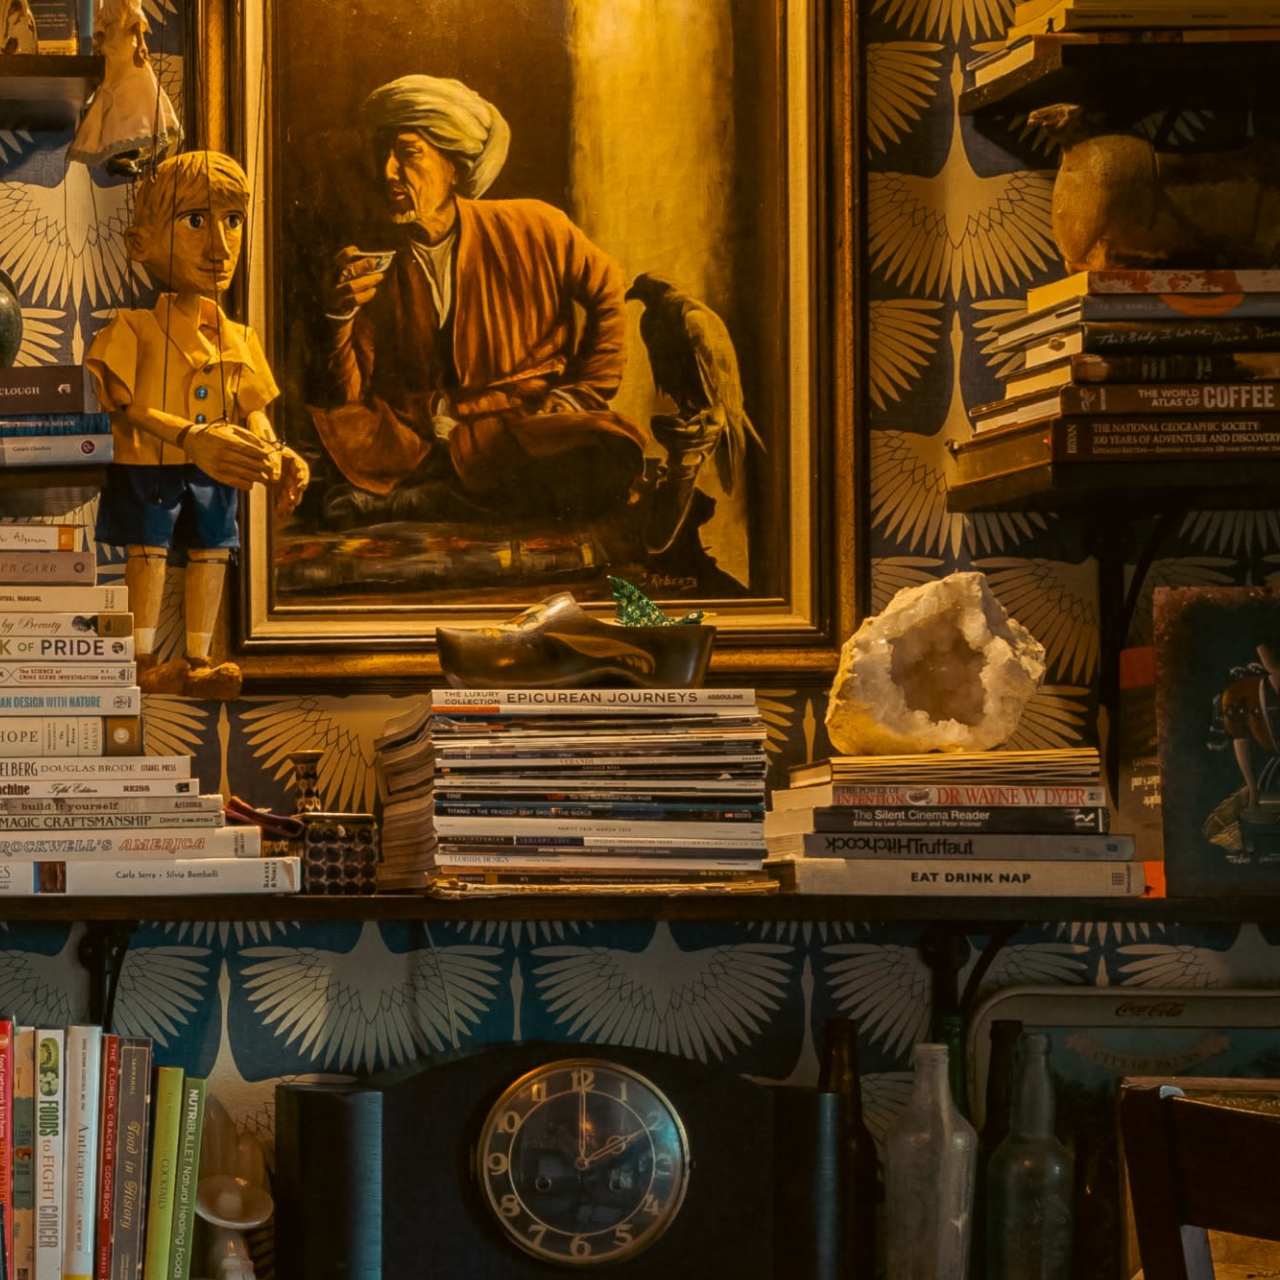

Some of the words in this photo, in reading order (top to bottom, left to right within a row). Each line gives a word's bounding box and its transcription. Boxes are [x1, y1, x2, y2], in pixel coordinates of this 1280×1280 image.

[1151, 398, 1183, 408] ATLAS
[1161, 388, 1200, 398] WORLD
[1202, 385, 1275, 409] COFFEE
[1112, 422, 1160, 433] NATIONAL
[1152, 433, 1208, 444] ADVENTURE
[17, 642, 35, 652] OF
[40, 639, 105, 657] PRIDE
[444, 698, 502, 706] COLLECTION
[506, 692, 603, 704] EPICUREAN
[606, 691, 700, 704] JOURNEYS
[40, 764, 96, 773] DOUGLAS
[963, 786, 1020, 806] WAYNE
[1044, 786, 1086, 805] DYER
[66, 800, 120, 813] yourself
[874, 809, 906, 820] Silent
[907, 809, 949, 820] Cinema
[950, 809, 991, 820] Reader
[42, 814, 152, 828] CRAFTSMANSHIP
[118, 837, 207, 852] AMERICA
[824, 836, 913, 854] Hitchcock
[910, 837, 975, 855] Truffaut
[910, 872, 938, 883] EAT
[944, 872, 994, 883] DRINK
[998, 872, 1032, 884] NAP
[1114, 1000, 1185, 1017] Coca-Cola
[571, 1070, 596, 1090] 12
[619, 1081, 629, 1101] 1
[39, 1100, 59, 1137] FOODS
[496, 1110, 522, 1134] 10
[488, 1152, 508, 1176] 9
[42, 1154, 55, 1201] FIGHT
[180, 1161, 193, 1201] Natural
[103, 1164, 113, 1220] COOKBOOK
[119, 1180, 138, 1233] History
[500, 1194, 521, 1217] 8
[643, 1193, 660, 1216] 4
[38, 1204, 58, 1248] CANCER
[528, 1224, 547, 1248] 7
[612, 1224, 633, 1246] 5
[569, 1235, 591, 1257] 6
